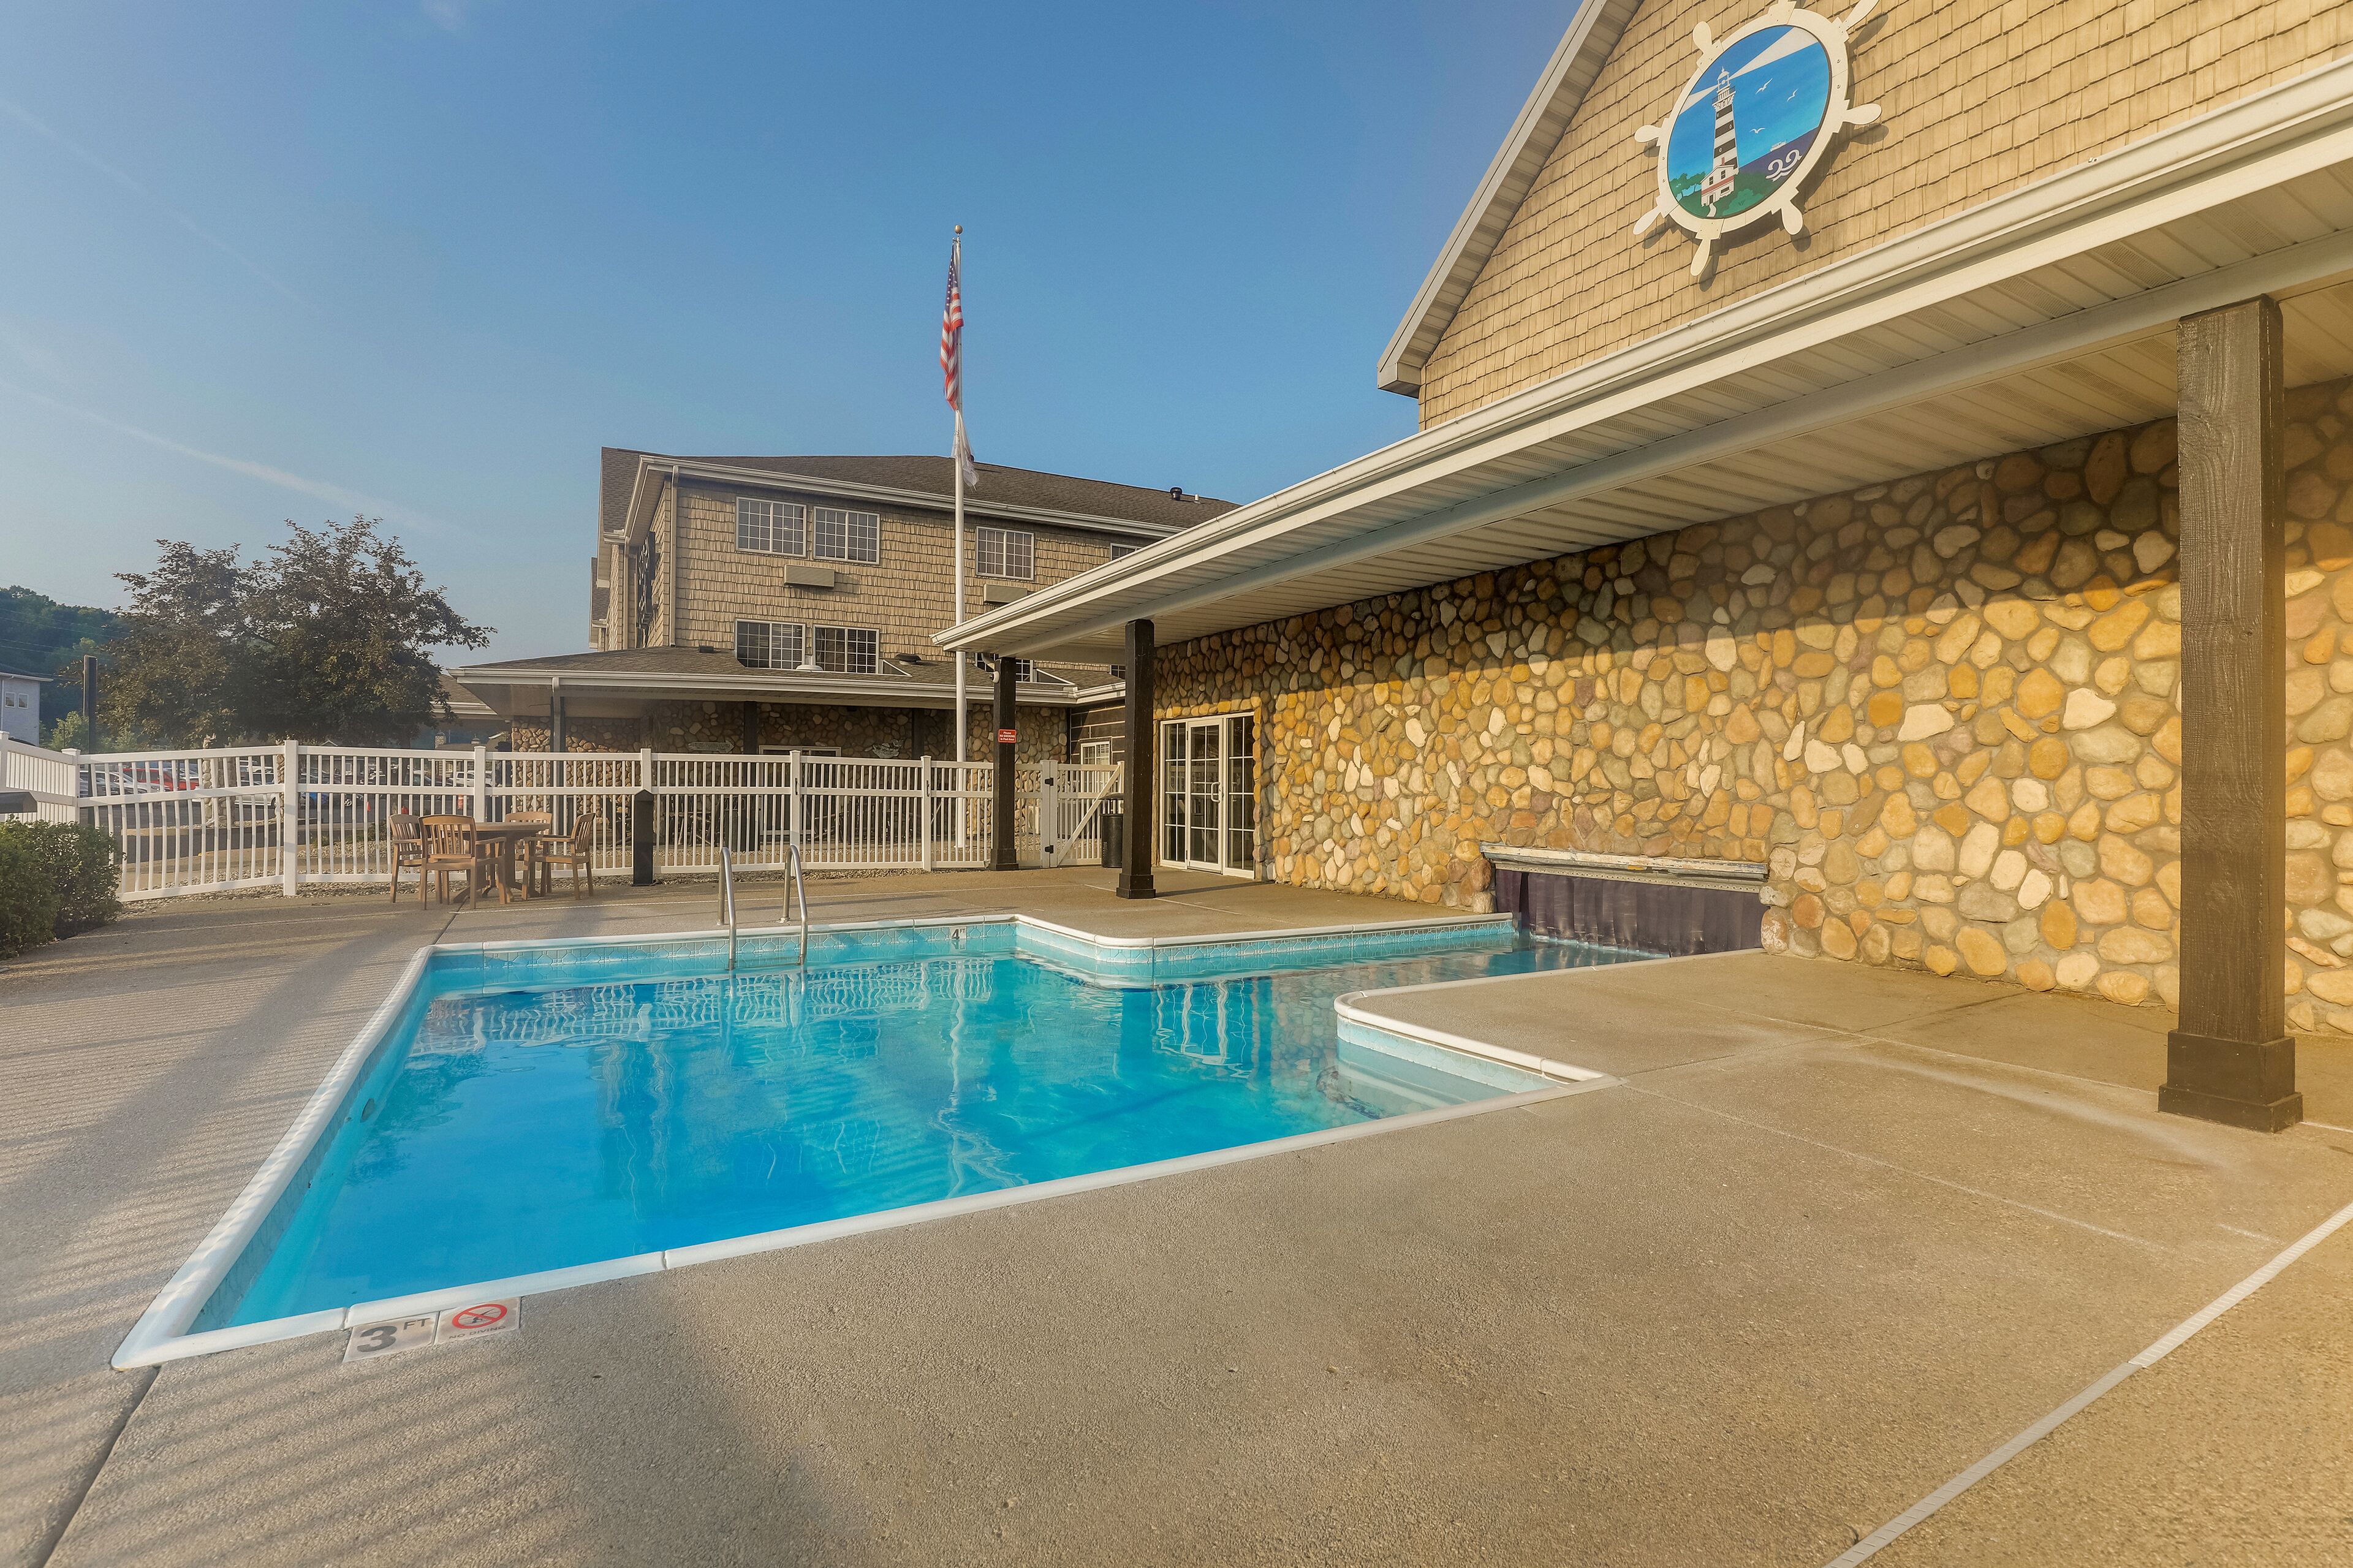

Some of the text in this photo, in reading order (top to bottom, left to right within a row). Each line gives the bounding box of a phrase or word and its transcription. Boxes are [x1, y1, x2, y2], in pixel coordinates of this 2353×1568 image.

[952, 929, 960, 939] 4
[357, 1317, 431, 1352] 3 FT
[469, 1325, 506, 1336] DIVING
